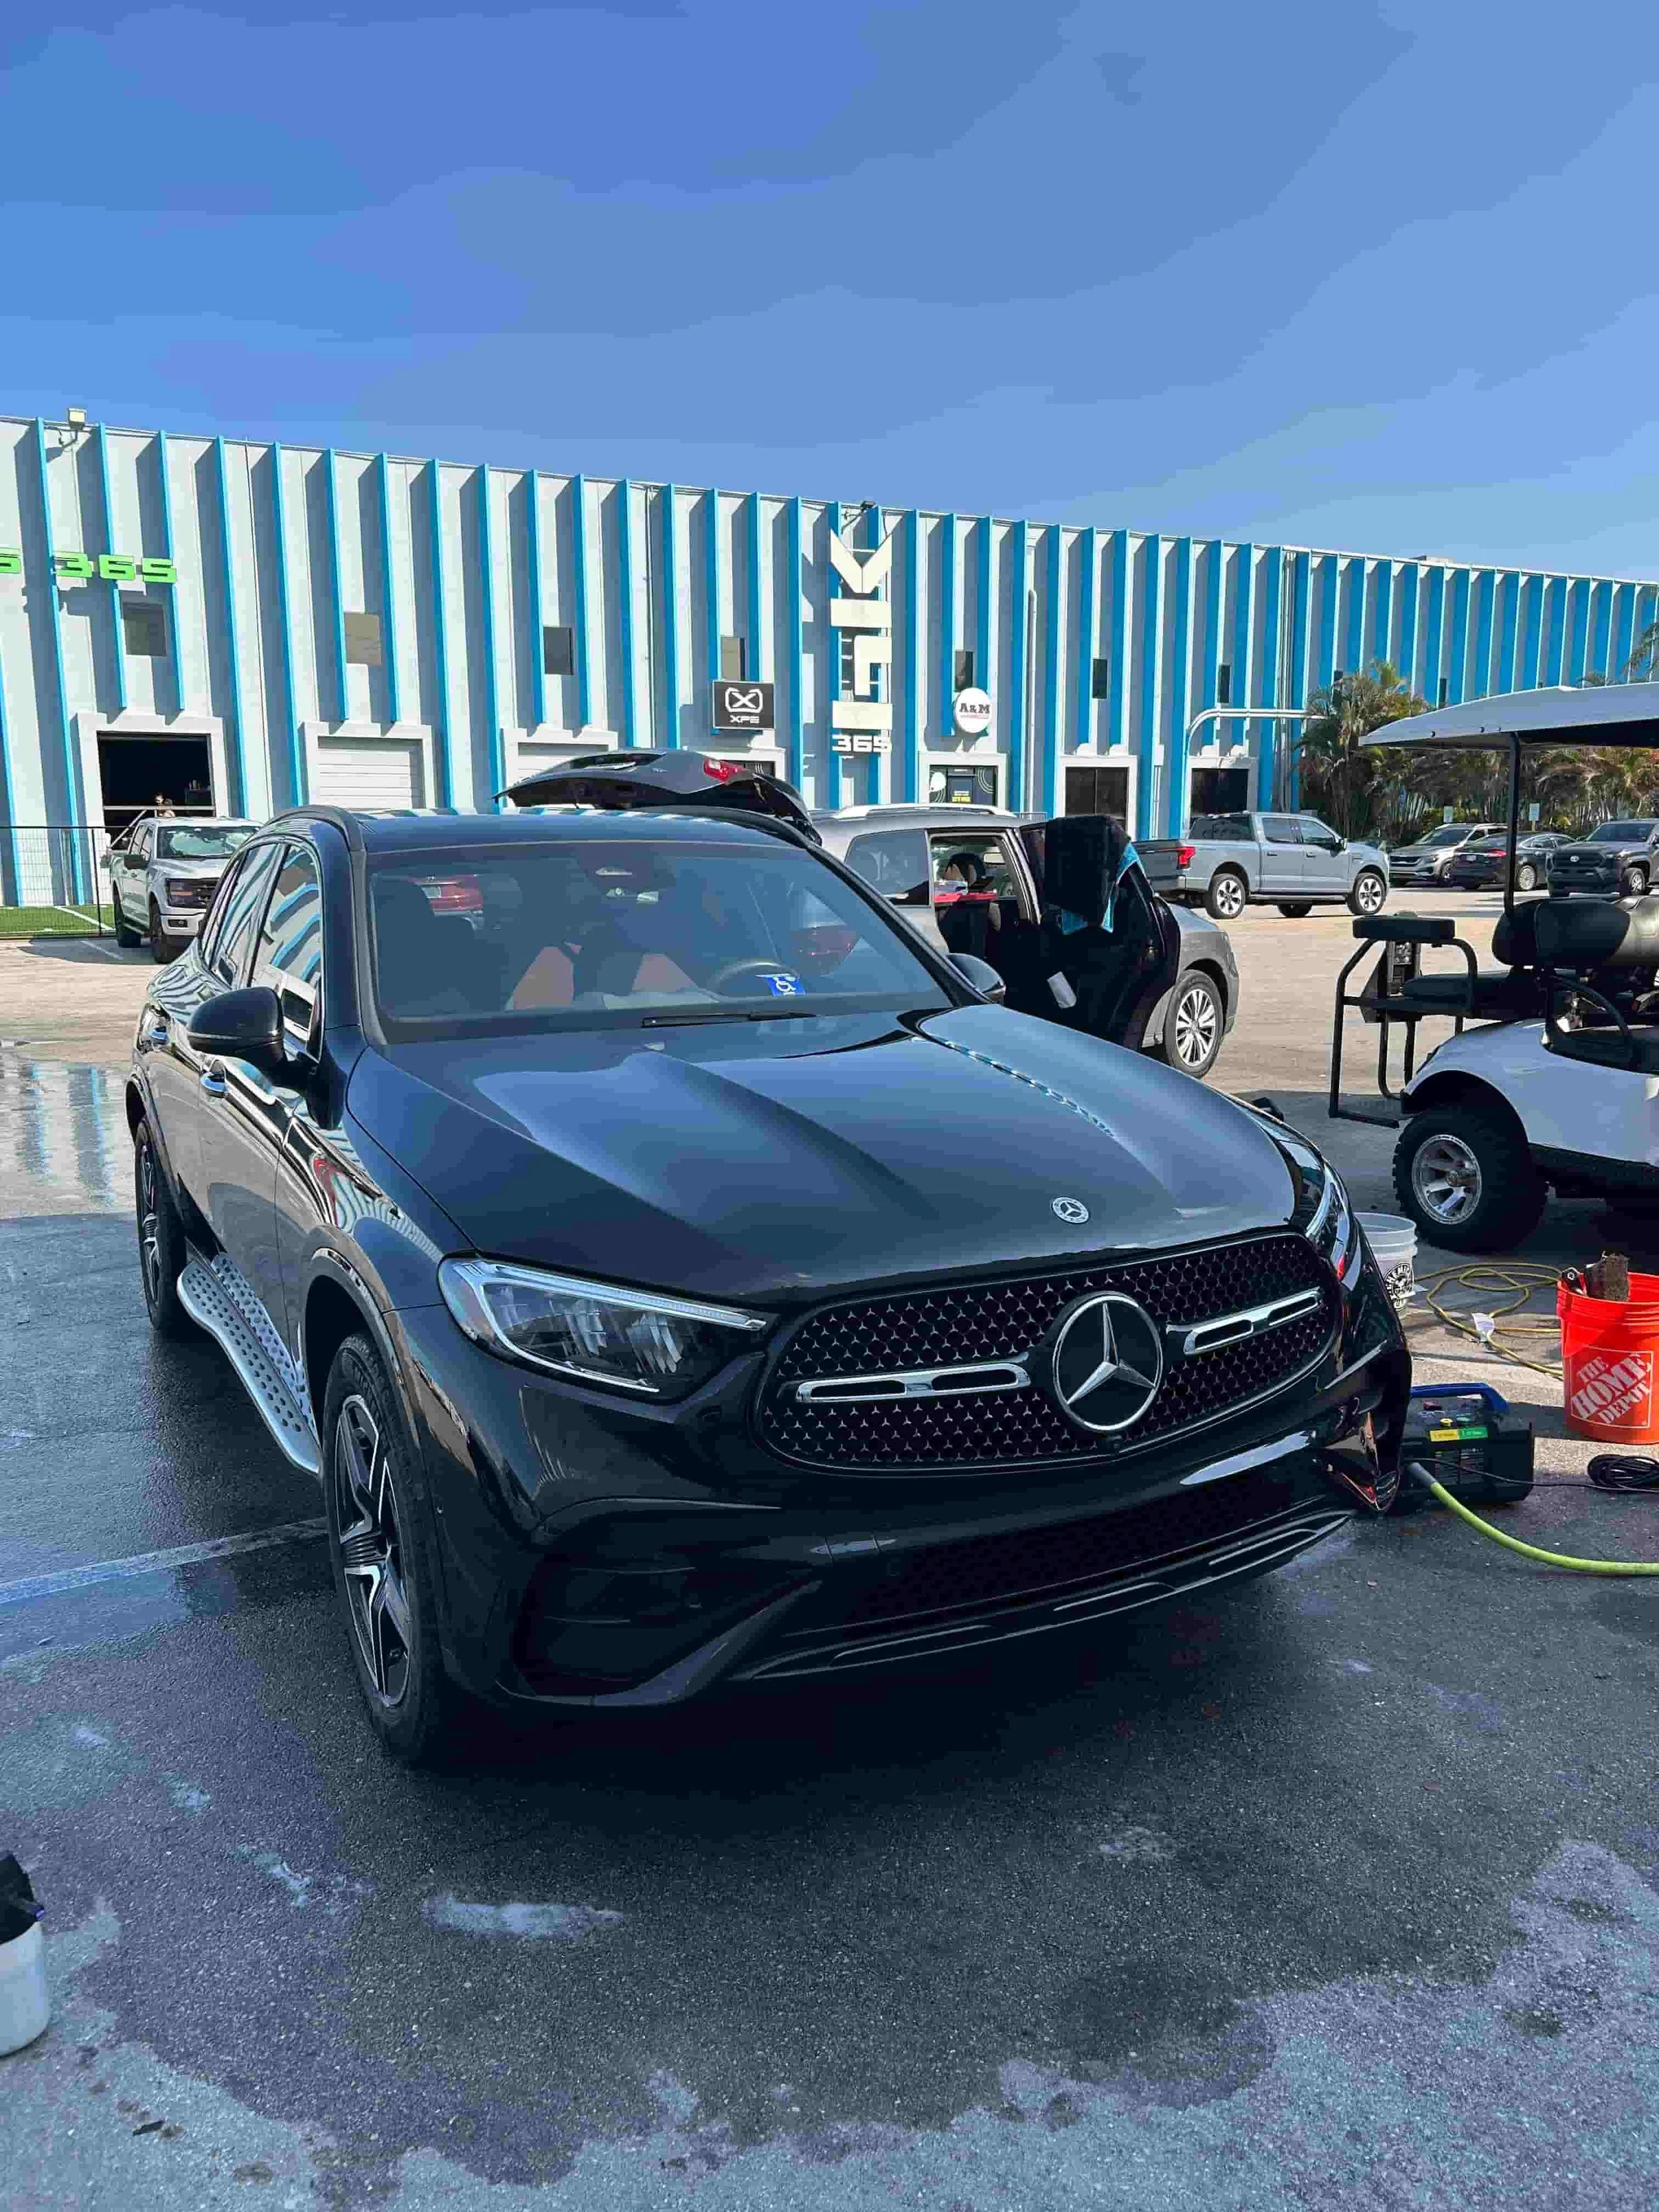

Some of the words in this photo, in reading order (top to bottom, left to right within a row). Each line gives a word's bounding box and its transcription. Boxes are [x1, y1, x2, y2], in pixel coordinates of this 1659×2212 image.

[53, 552, 177, 583] 365
[959, 703, 990, 714] A&M
[832, 735, 892, 753] 365
[1577, 1357, 1609, 1383] THE
[1597, 1381, 1650, 1424] DEPOT
